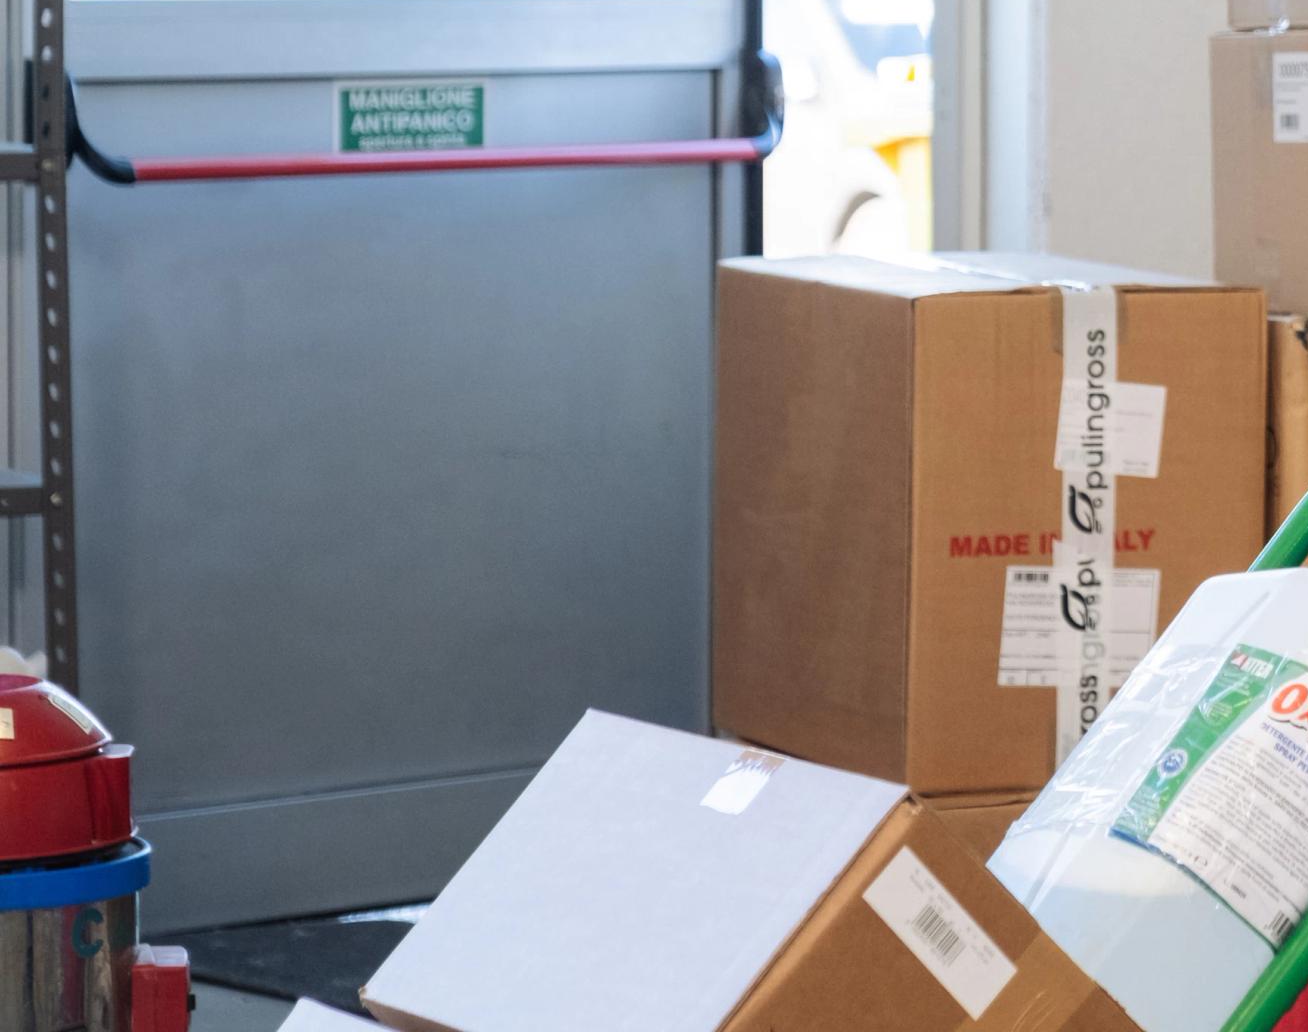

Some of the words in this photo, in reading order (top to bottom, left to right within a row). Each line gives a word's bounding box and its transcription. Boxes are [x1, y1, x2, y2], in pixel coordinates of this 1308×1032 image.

[349, 87, 475, 110] MANIGLIONE
[350, 110, 475, 135] ANTIPANICO
[1081, 329, 1111, 490] pulingross
[950, 533, 1030, 558] MADE
